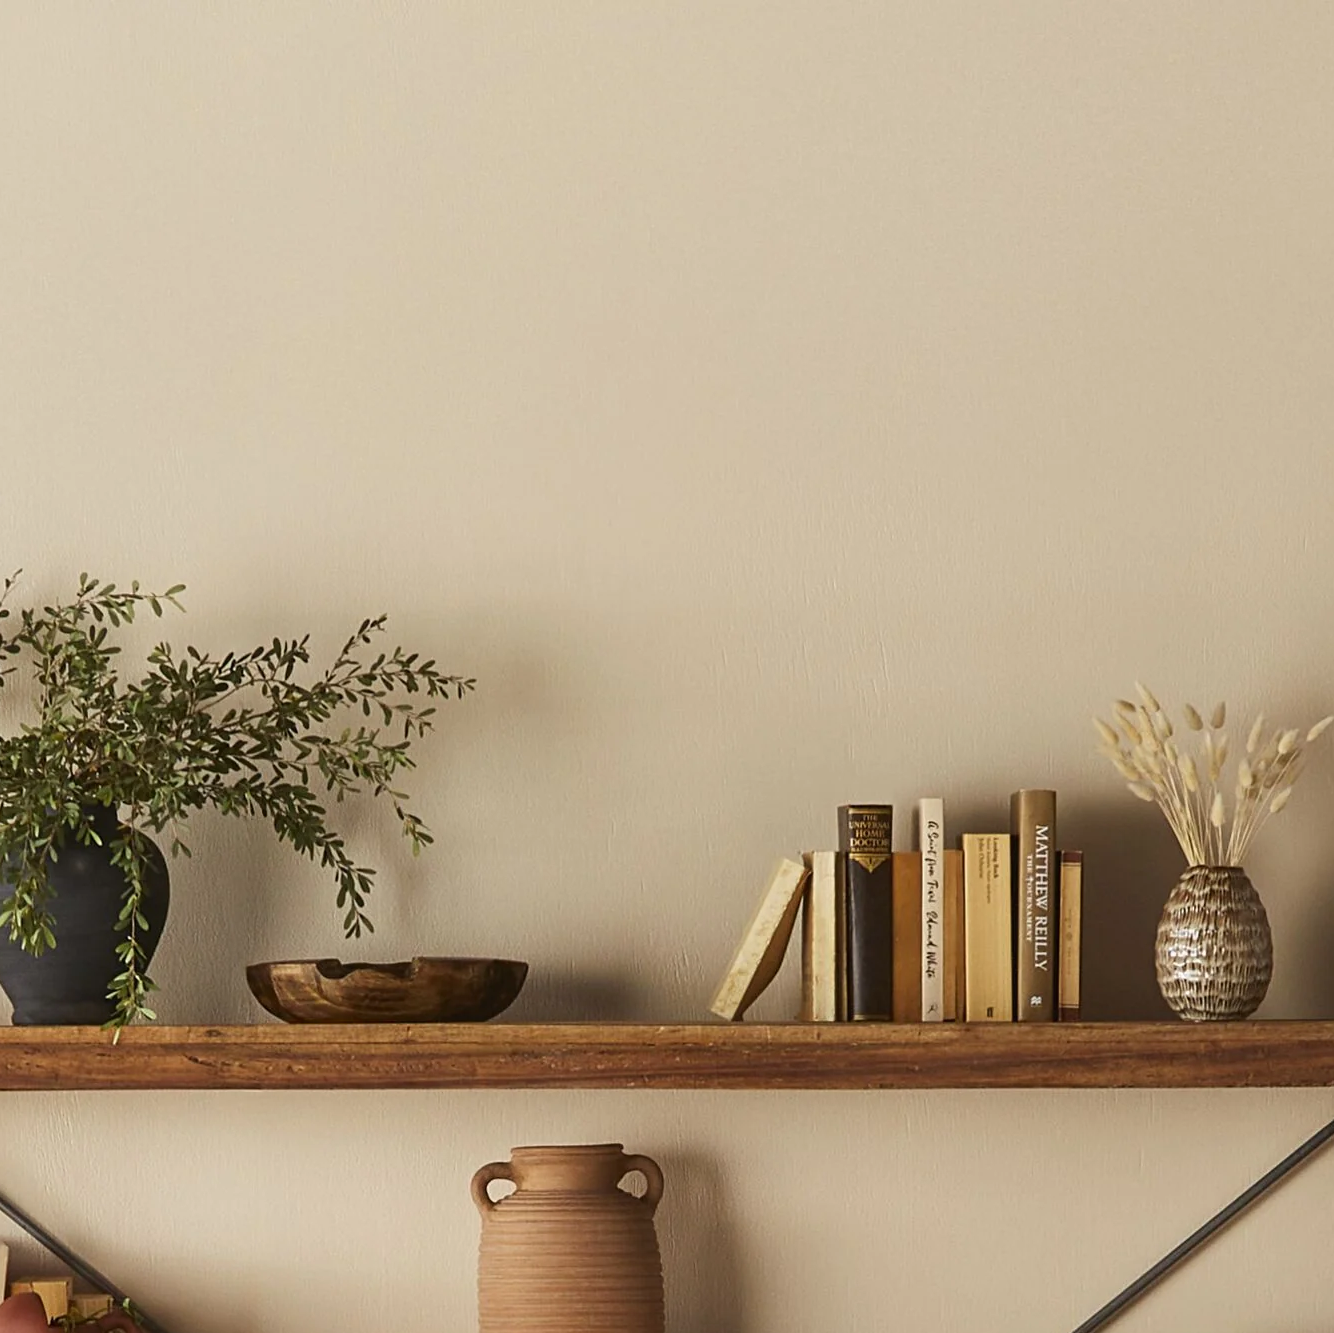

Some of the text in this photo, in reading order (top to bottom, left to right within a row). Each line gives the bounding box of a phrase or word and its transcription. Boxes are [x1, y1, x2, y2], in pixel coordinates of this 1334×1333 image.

[849, 821, 890, 829] UNIVERSAL
[855, 829, 884, 838] HOME
[849, 838, 889, 847] DOCTOR
[927, 832, 939, 855] Saint
[992, 837, 1000, 862] Looking
[1025, 854, 1035, 942] THE TOURNAMENT
[1034, 825, 1049, 971] MATTHEW REILLY
[926, 911, 939, 979] Edmund White
